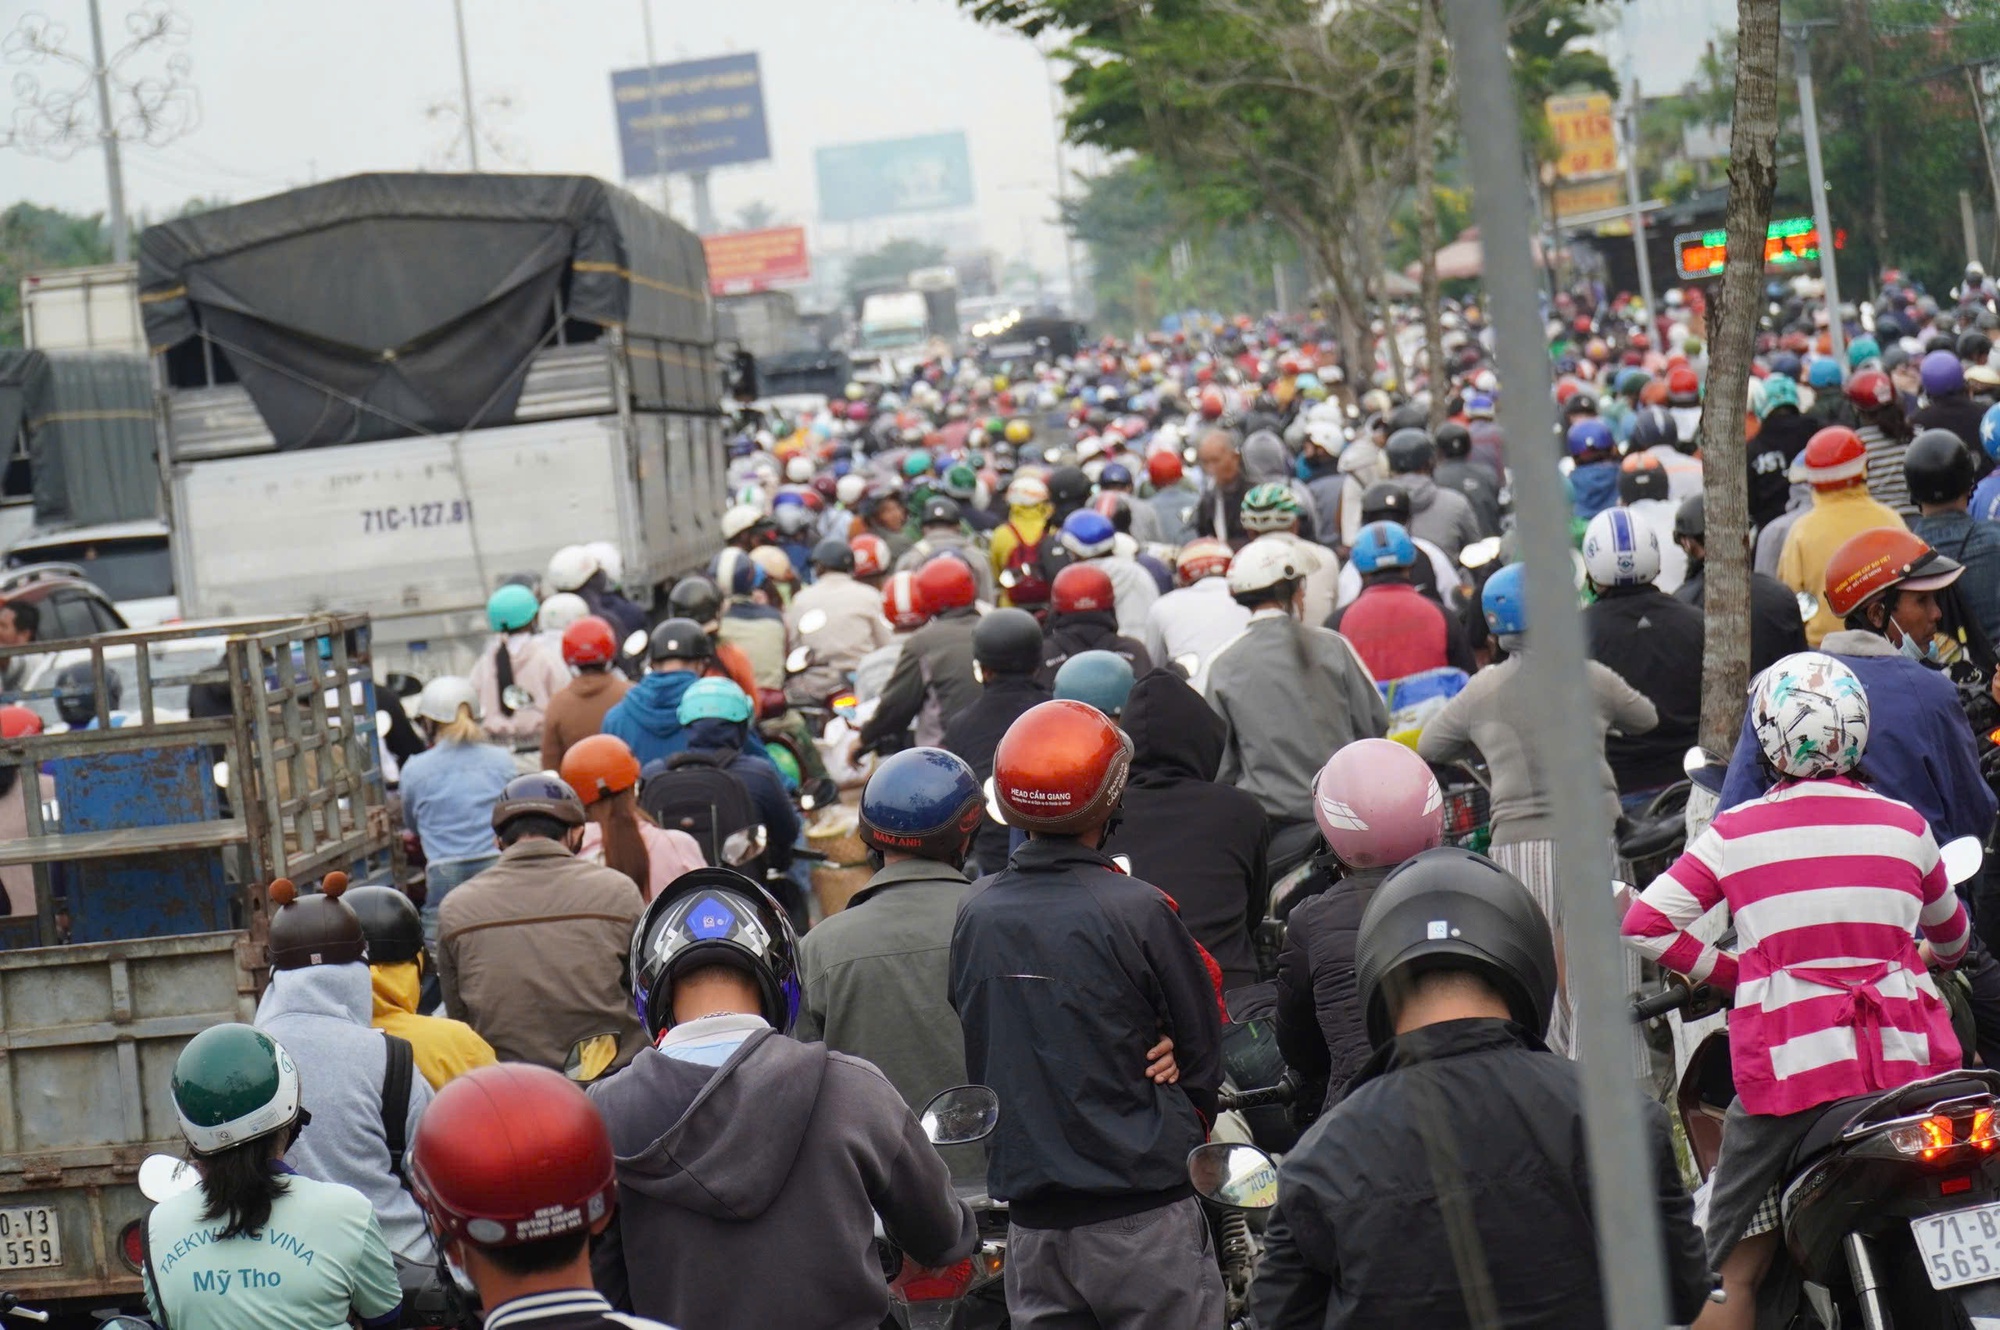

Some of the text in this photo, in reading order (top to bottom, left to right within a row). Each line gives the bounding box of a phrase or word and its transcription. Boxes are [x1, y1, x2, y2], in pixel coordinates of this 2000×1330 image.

[1011, 787, 1028, 798] HEAD
[1047, 792, 1071, 800] GIANG
[873, 830, 922, 847] NAM ANH
[270, 1228, 315, 1267] VINA
[193, 1268, 281, 1296] Mỹ Tho
